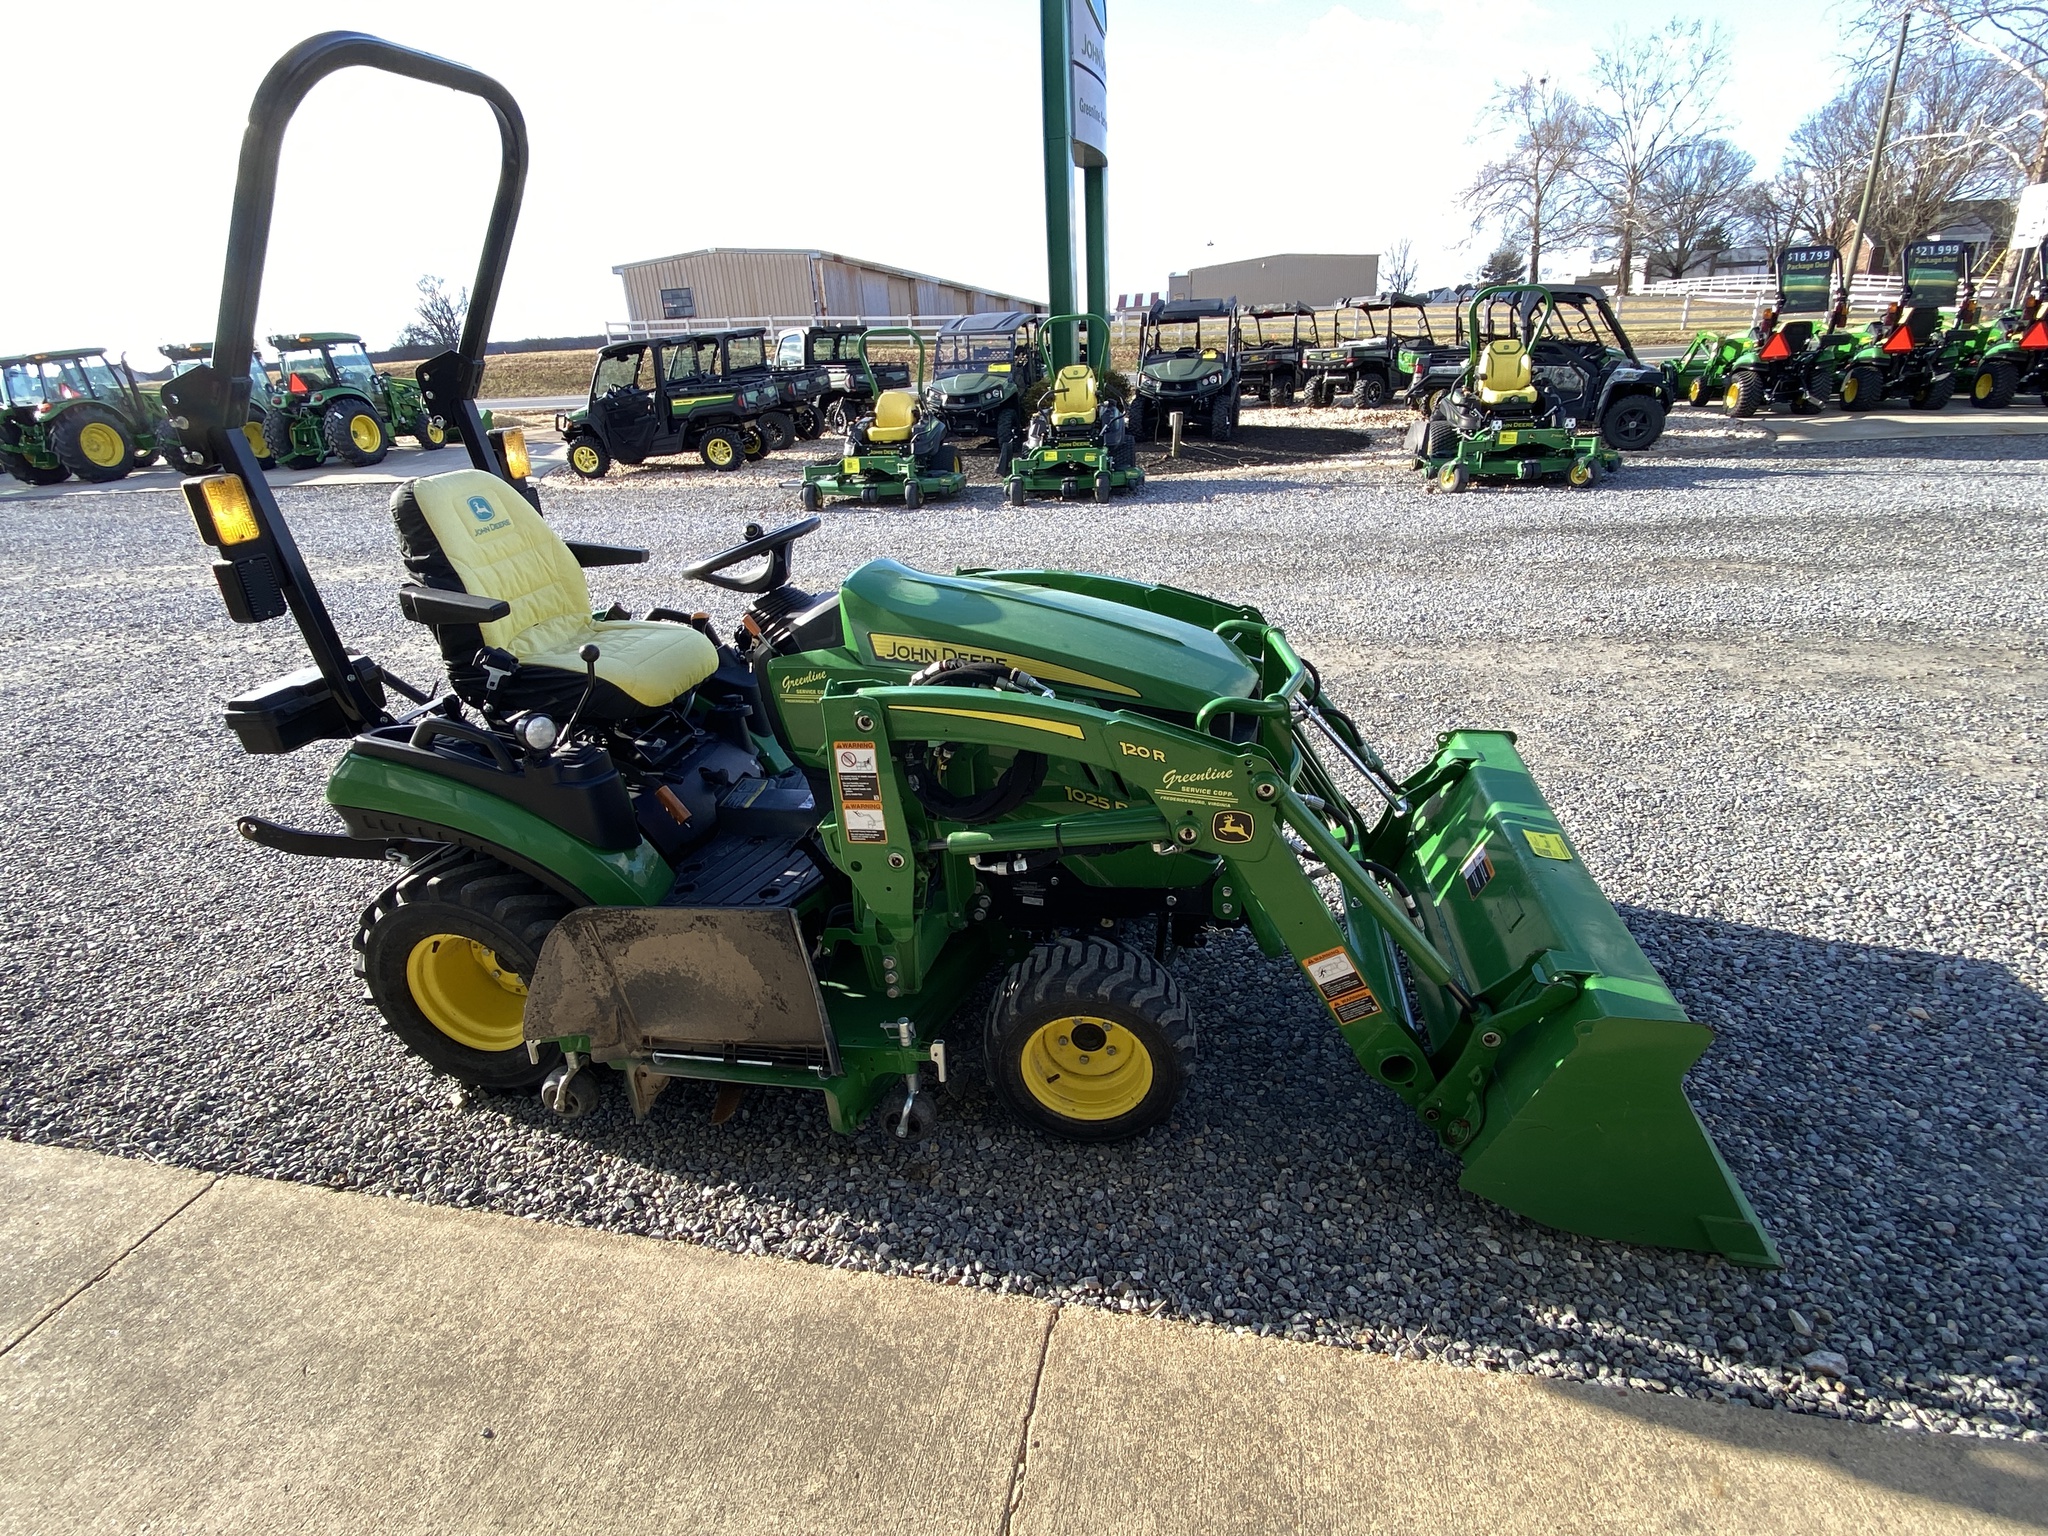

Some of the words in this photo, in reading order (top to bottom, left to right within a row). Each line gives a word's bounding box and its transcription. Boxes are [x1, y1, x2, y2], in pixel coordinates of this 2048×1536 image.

[1081, 34, 1101, 67] JOHN
[1787, 263, 1814, 271] Package
[1815, 261, 1830, 269] Deal
[475, 526, 490, 537] JOHN
[489, 519, 511, 531] DEERE
[887, 642, 937, 663] JOHN
[782, 670, 827, 693] Greenline
[1162, 767, 1233, 789] Greenline
[1181, 786, 1212, 796] SERVICE
